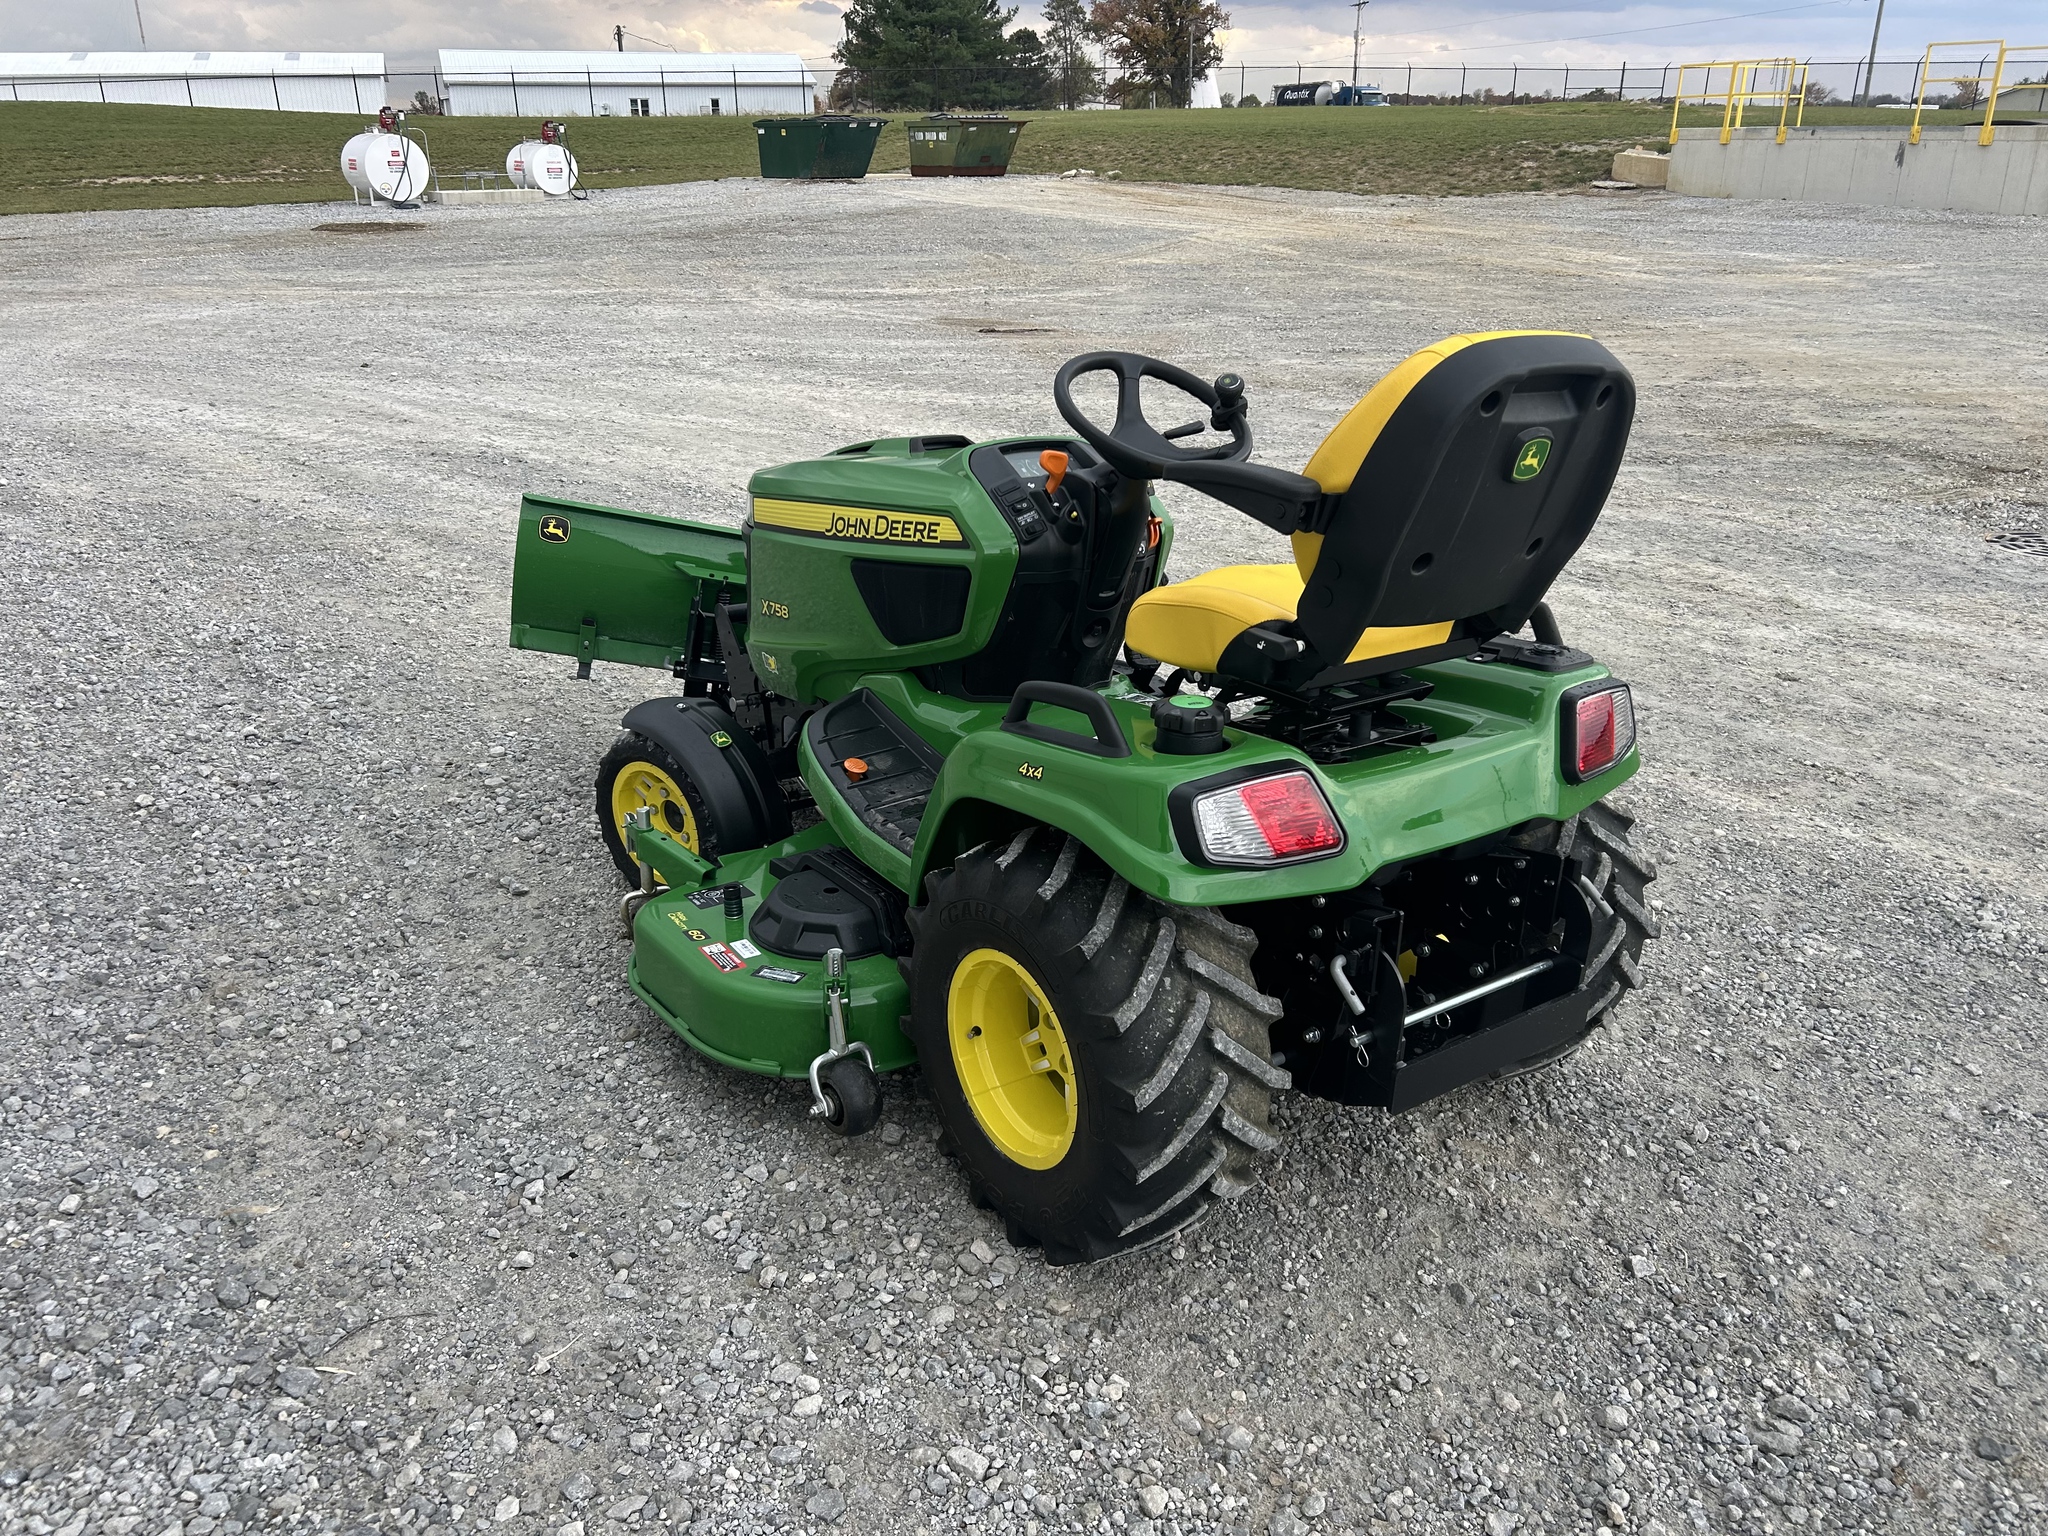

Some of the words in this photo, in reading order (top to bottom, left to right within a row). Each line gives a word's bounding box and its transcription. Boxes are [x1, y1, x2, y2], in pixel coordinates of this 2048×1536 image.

[1284, 89, 1311, 100] Quantix
[825, 512, 871, 538] JOHN
[874, 515, 941, 543] DEERE
[761, 599, 789, 619] X758
[1019, 762, 1044, 780] 4x4
[688, 929, 706, 941] 60
[947, 900, 1063, 984] CARLISLE
